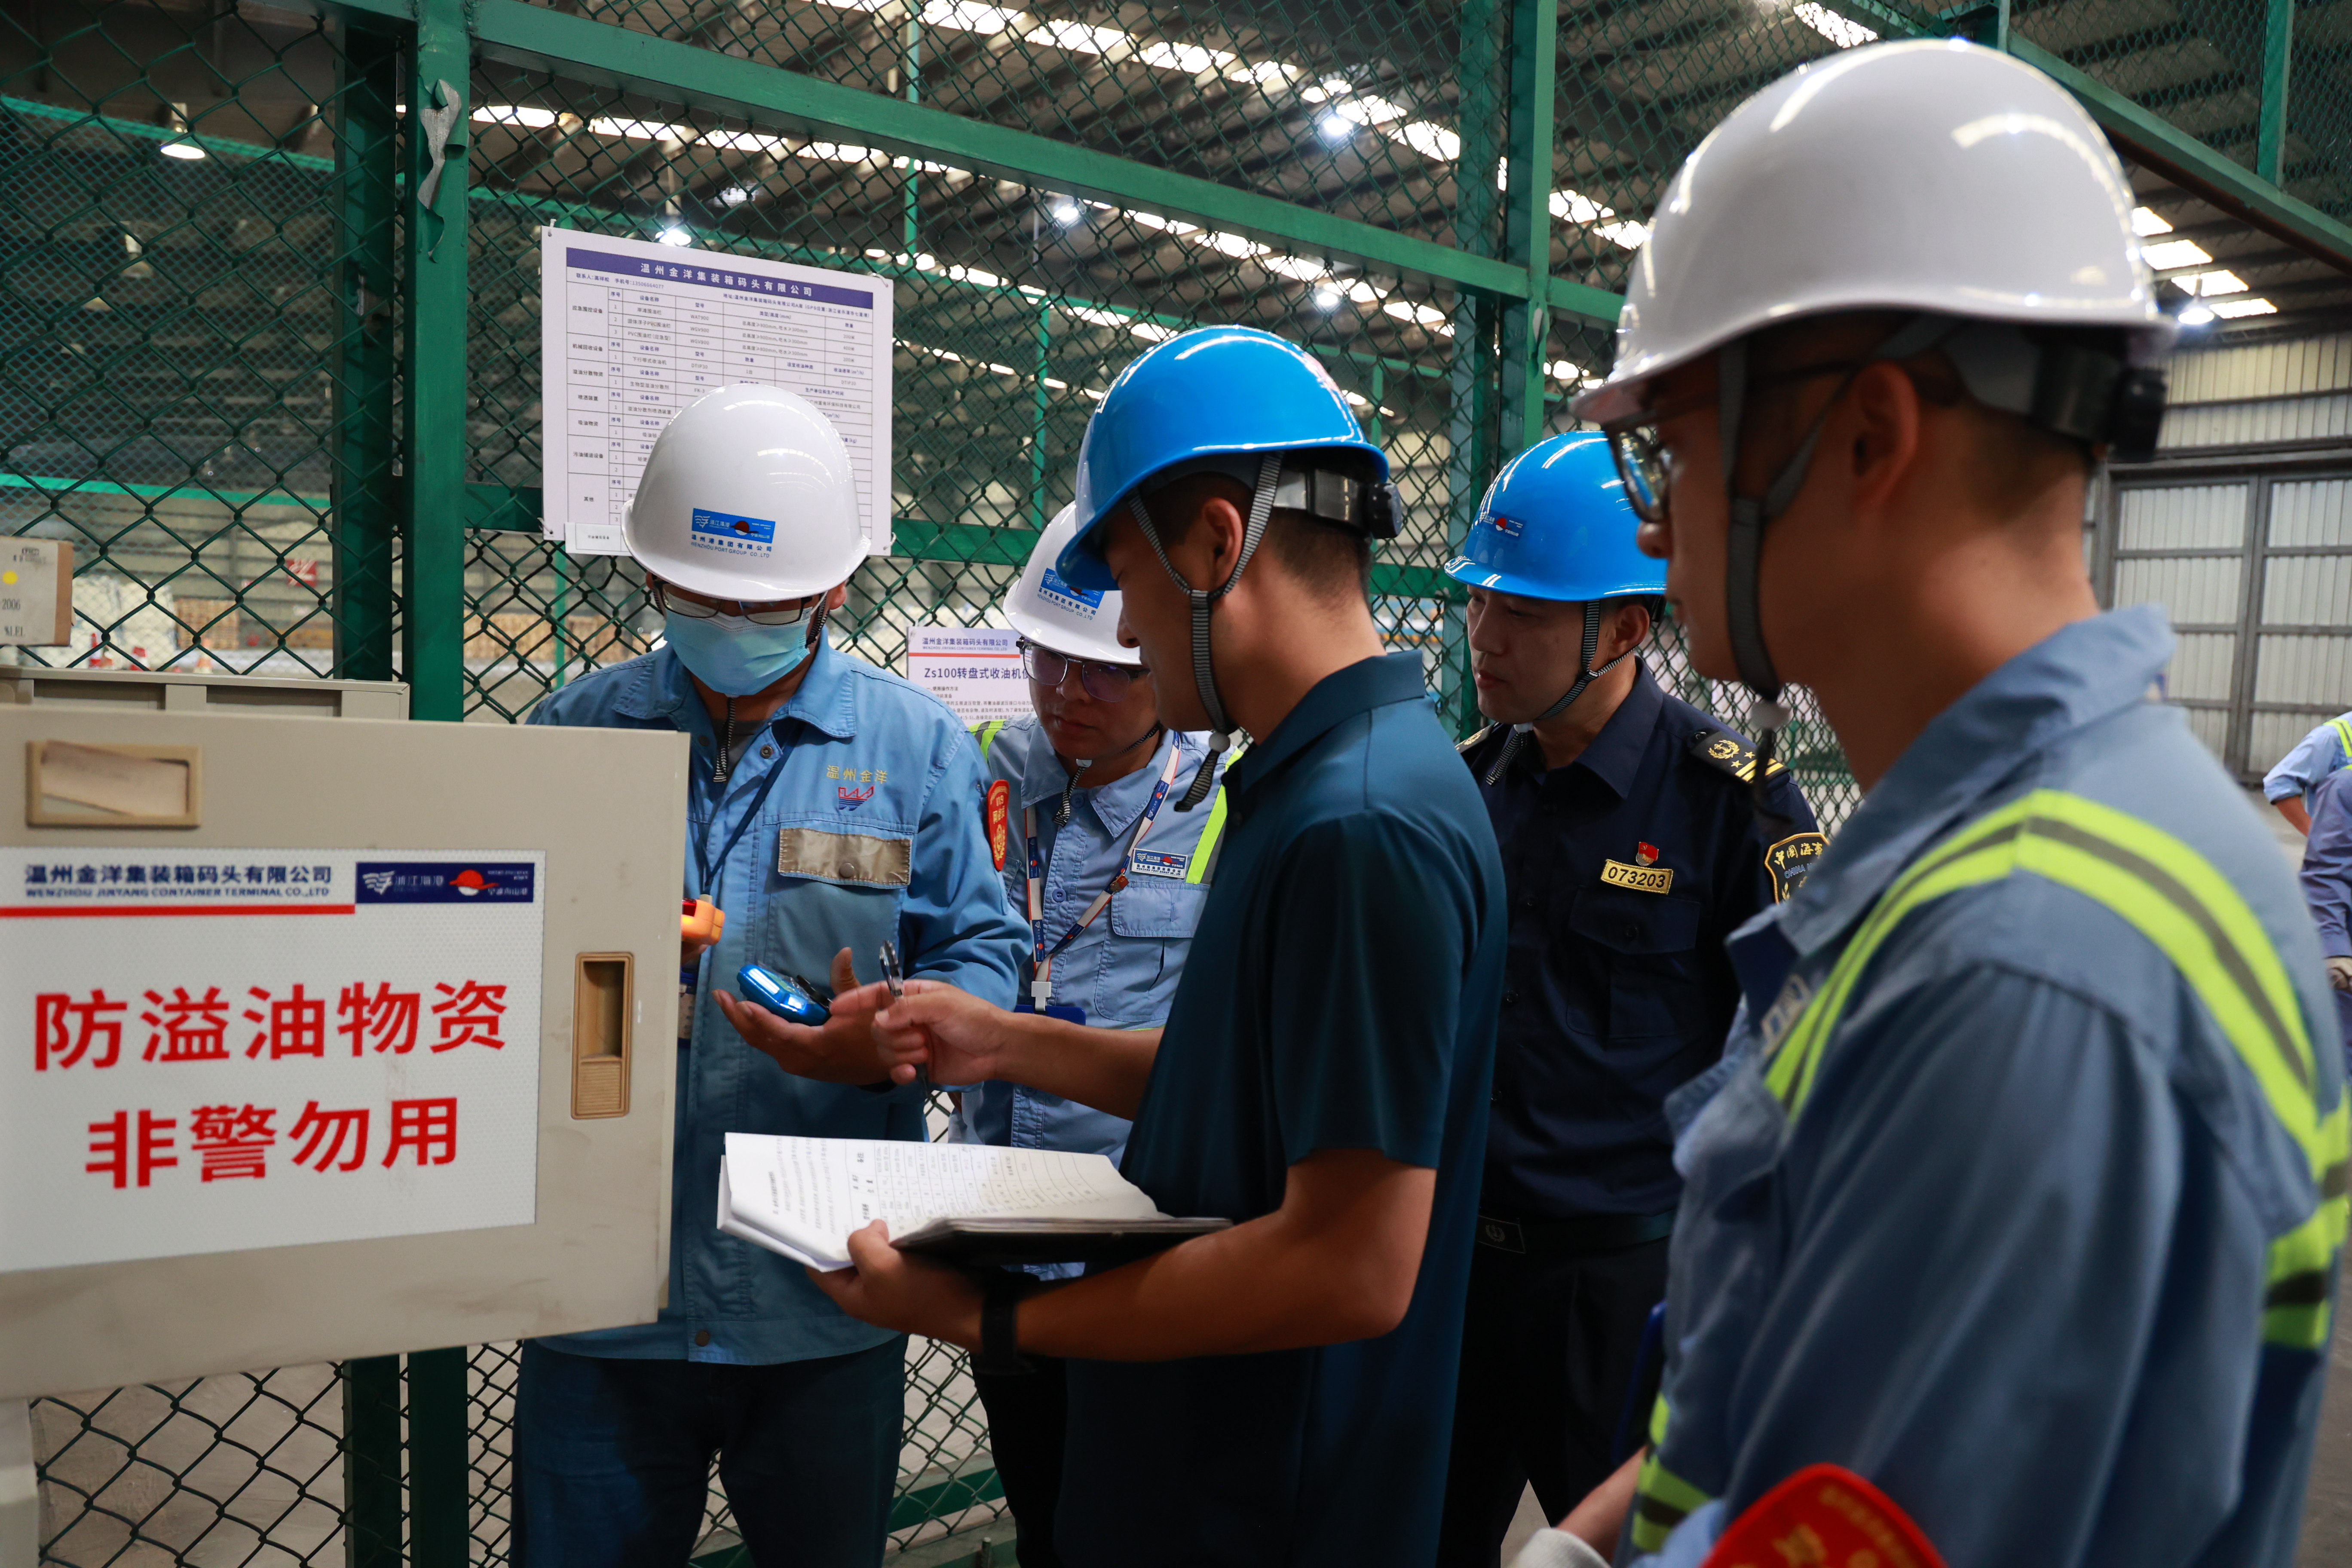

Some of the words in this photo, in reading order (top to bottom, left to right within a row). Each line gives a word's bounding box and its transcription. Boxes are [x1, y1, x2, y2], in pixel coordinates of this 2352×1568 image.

[640, 263, 812, 297] 温州金洋集装箱码头有限公司
[572, 305, 603, 314] 应急围控设备
[573, 343, 603, 352] 机械回收设备
[573, 369, 603, 377] 溢油分散物资
[630, 381, 669, 390] 生物型溢油分散剂
[628, 405, 671, 415] 溢油分散剂喷洒装置
[691, 542, 714, 550] WENZHOU
[692, 534, 772, 552] 温州港集团有限公司
[1038, 587, 1096, 616] 温州港集团有限公司
[1060, 605, 1075, 613] GROUP
[922, 637, 1008, 646] 温州金洋集装箱码头有限公司
[826, 765, 888, 784] 温州金洋
[1774, 842, 1823, 870] 中国海事
[24, 864, 333, 884] 温州金洋集装箱码头有限公司
[1608, 866, 1666, 888] 073203
[1784, 864, 1805, 879] CHINA
[26, 888, 92, 897] WENZHOU
[97, 889, 149, 897] JINYANG
[152, 888, 222, 897] CONTAINER
[225, 888, 282, 897] TERMINAL
[34, 979, 508, 1072] 防溢油物资
[86, 1096, 458, 1190] 非警勿用
